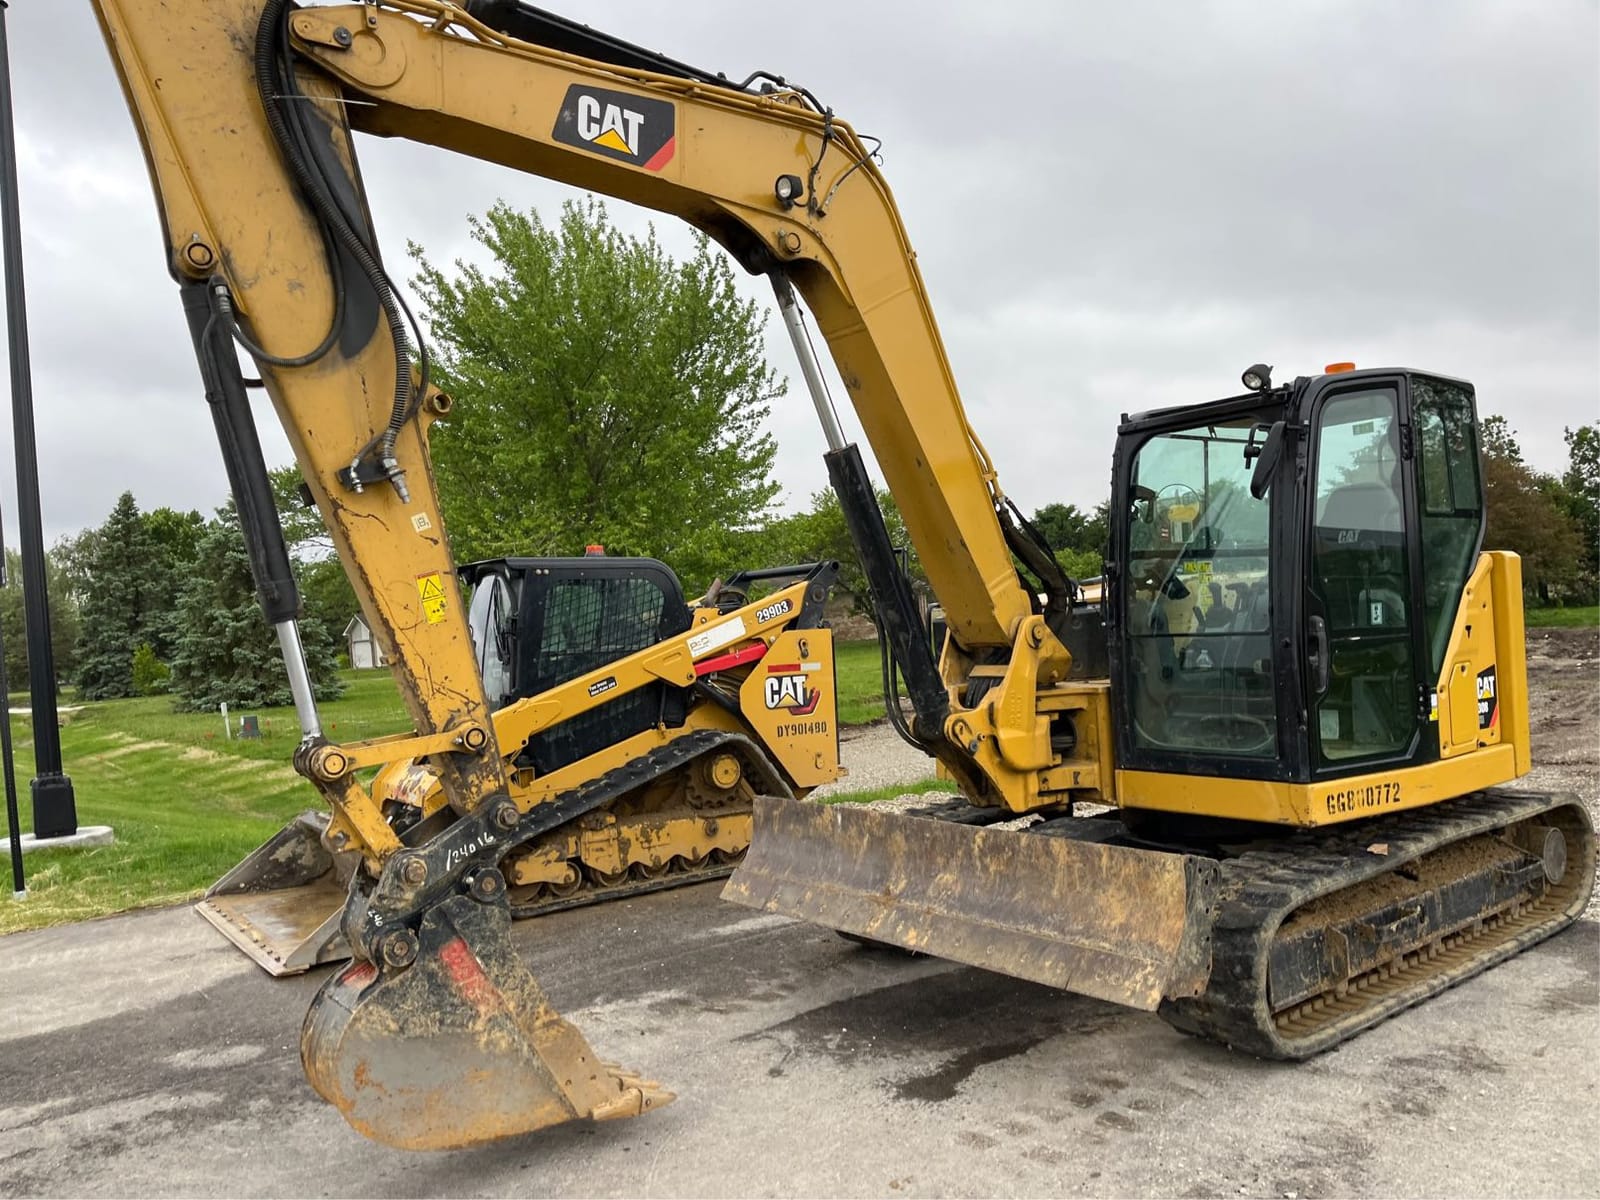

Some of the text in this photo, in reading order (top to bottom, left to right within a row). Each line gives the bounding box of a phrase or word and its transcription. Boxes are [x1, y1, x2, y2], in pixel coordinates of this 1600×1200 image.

[577, 95, 645, 156] CAT
[1338, 530, 1360, 544] CAT
[756, 600, 789, 623] 299D3
[765, 675, 806, 709] CAT
[1476, 675, 1495, 700] CAT
[1477, 701, 1489, 714] 308
[777, 721, 827, 737] DY901480
